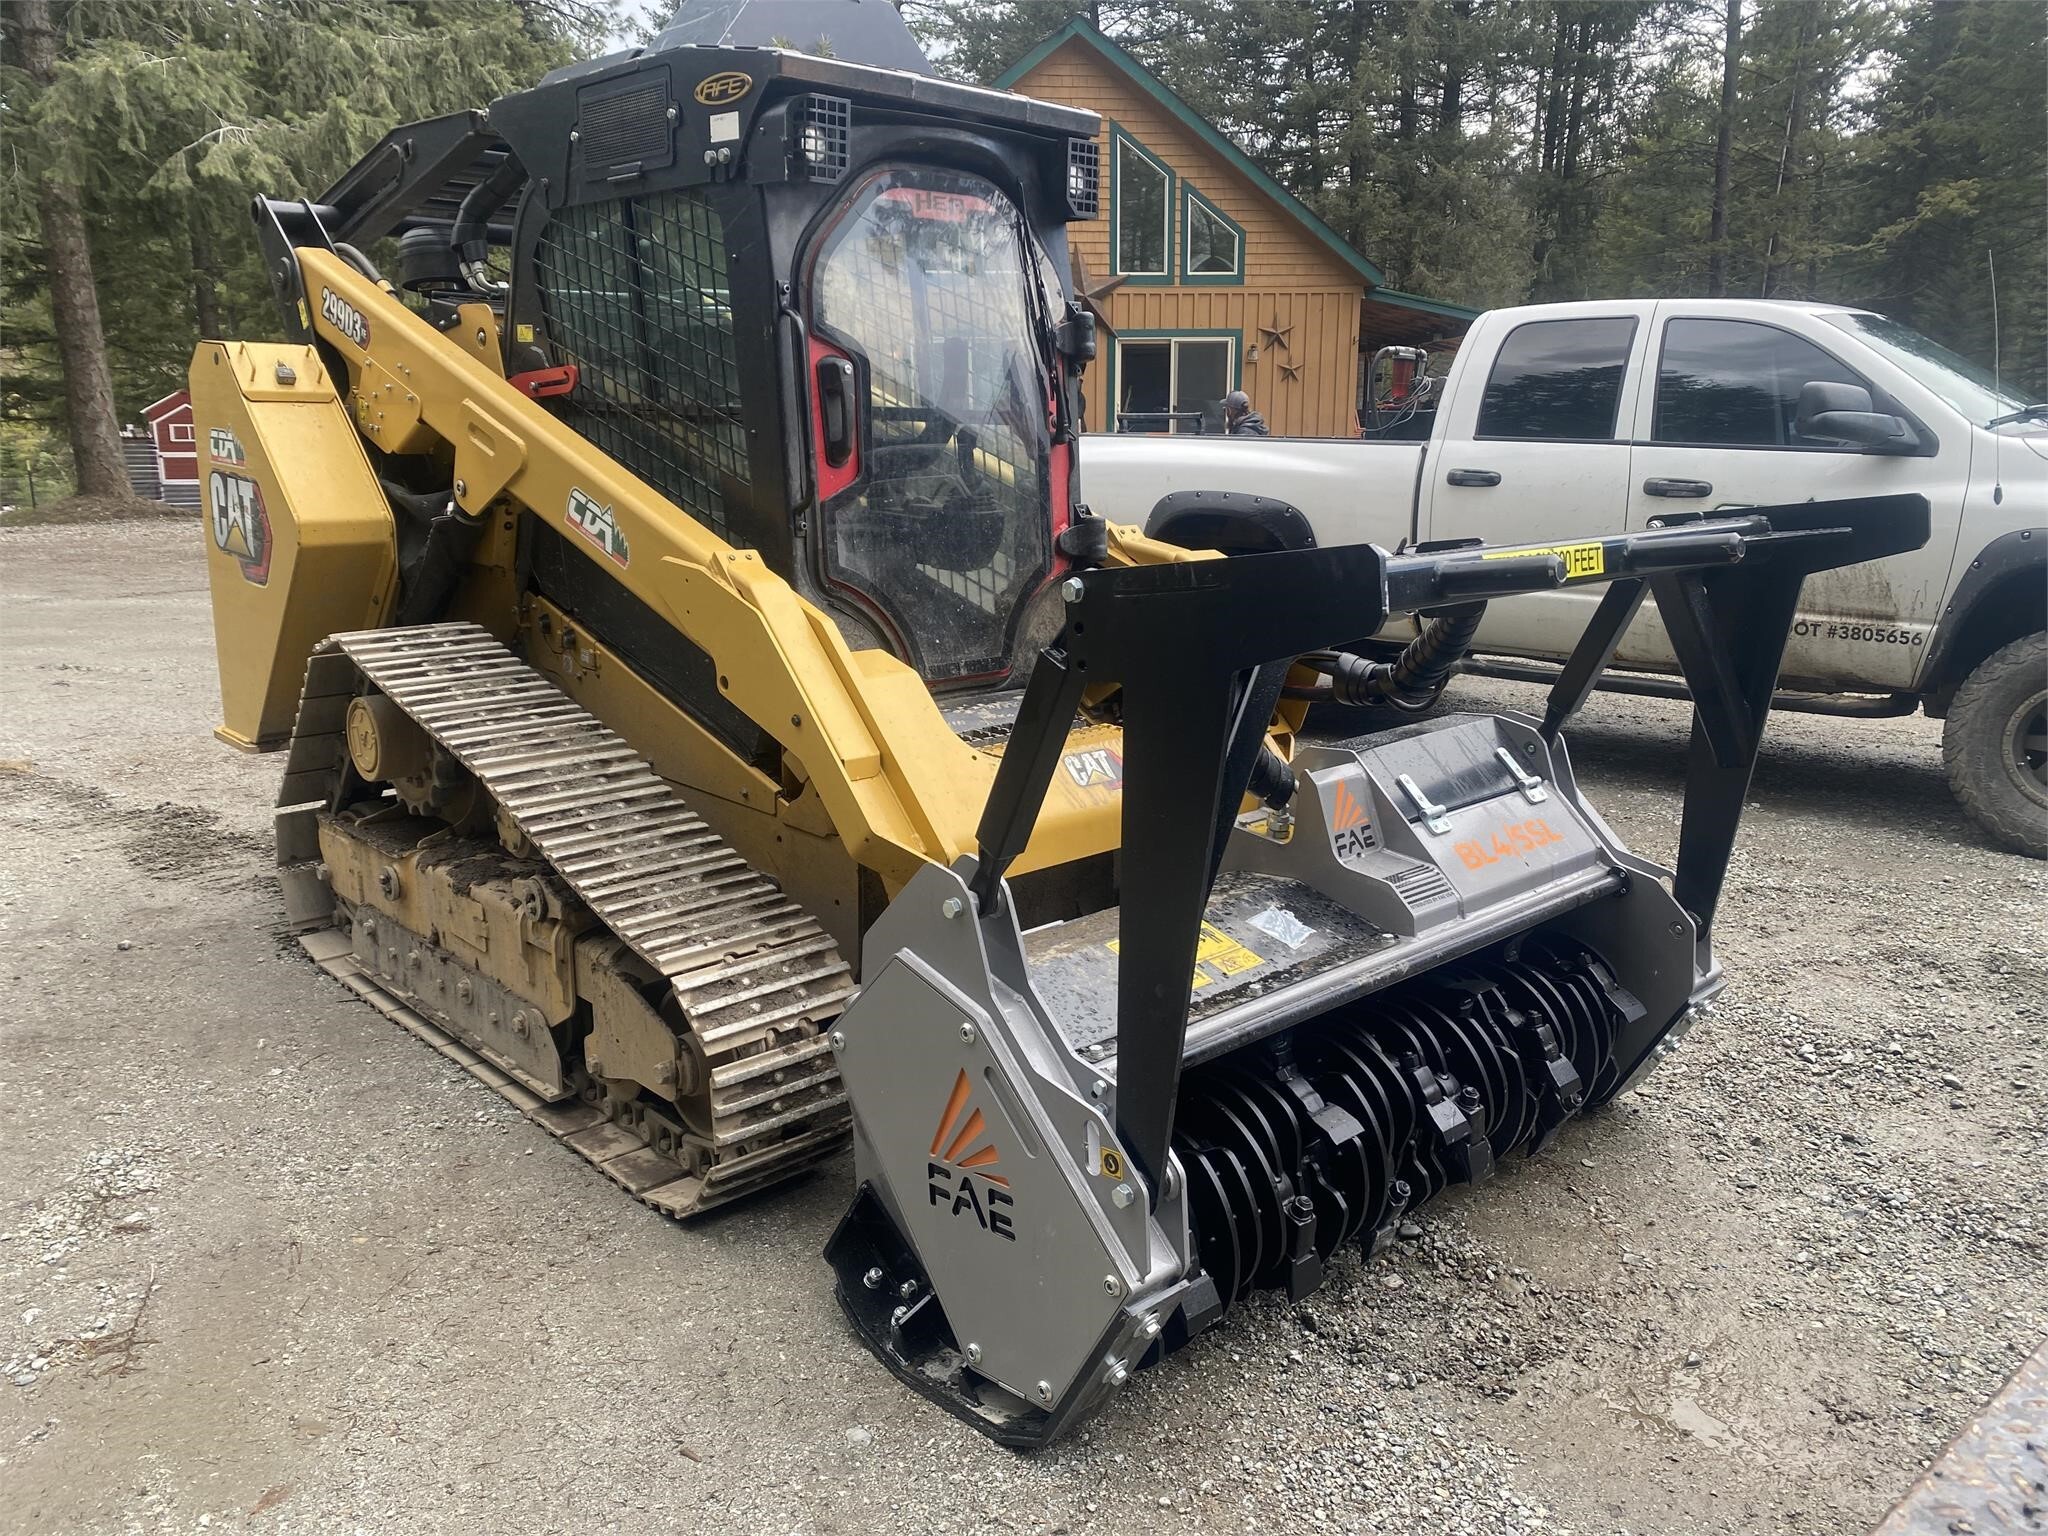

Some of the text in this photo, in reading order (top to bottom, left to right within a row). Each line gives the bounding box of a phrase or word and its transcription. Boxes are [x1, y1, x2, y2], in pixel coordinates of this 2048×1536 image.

[700, 75, 747, 101] AFE
[321, 286, 362, 344] 299D3
[210, 471, 256, 559] CAT
[1574, 546, 1601, 573] FEET
[1793, 622, 1923, 646] OT #3805656
[1064, 749, 1118, 787] CAT
[1334, 824, 1376, 857] FAE
[928, 1162, 1016, 1242] FAE
